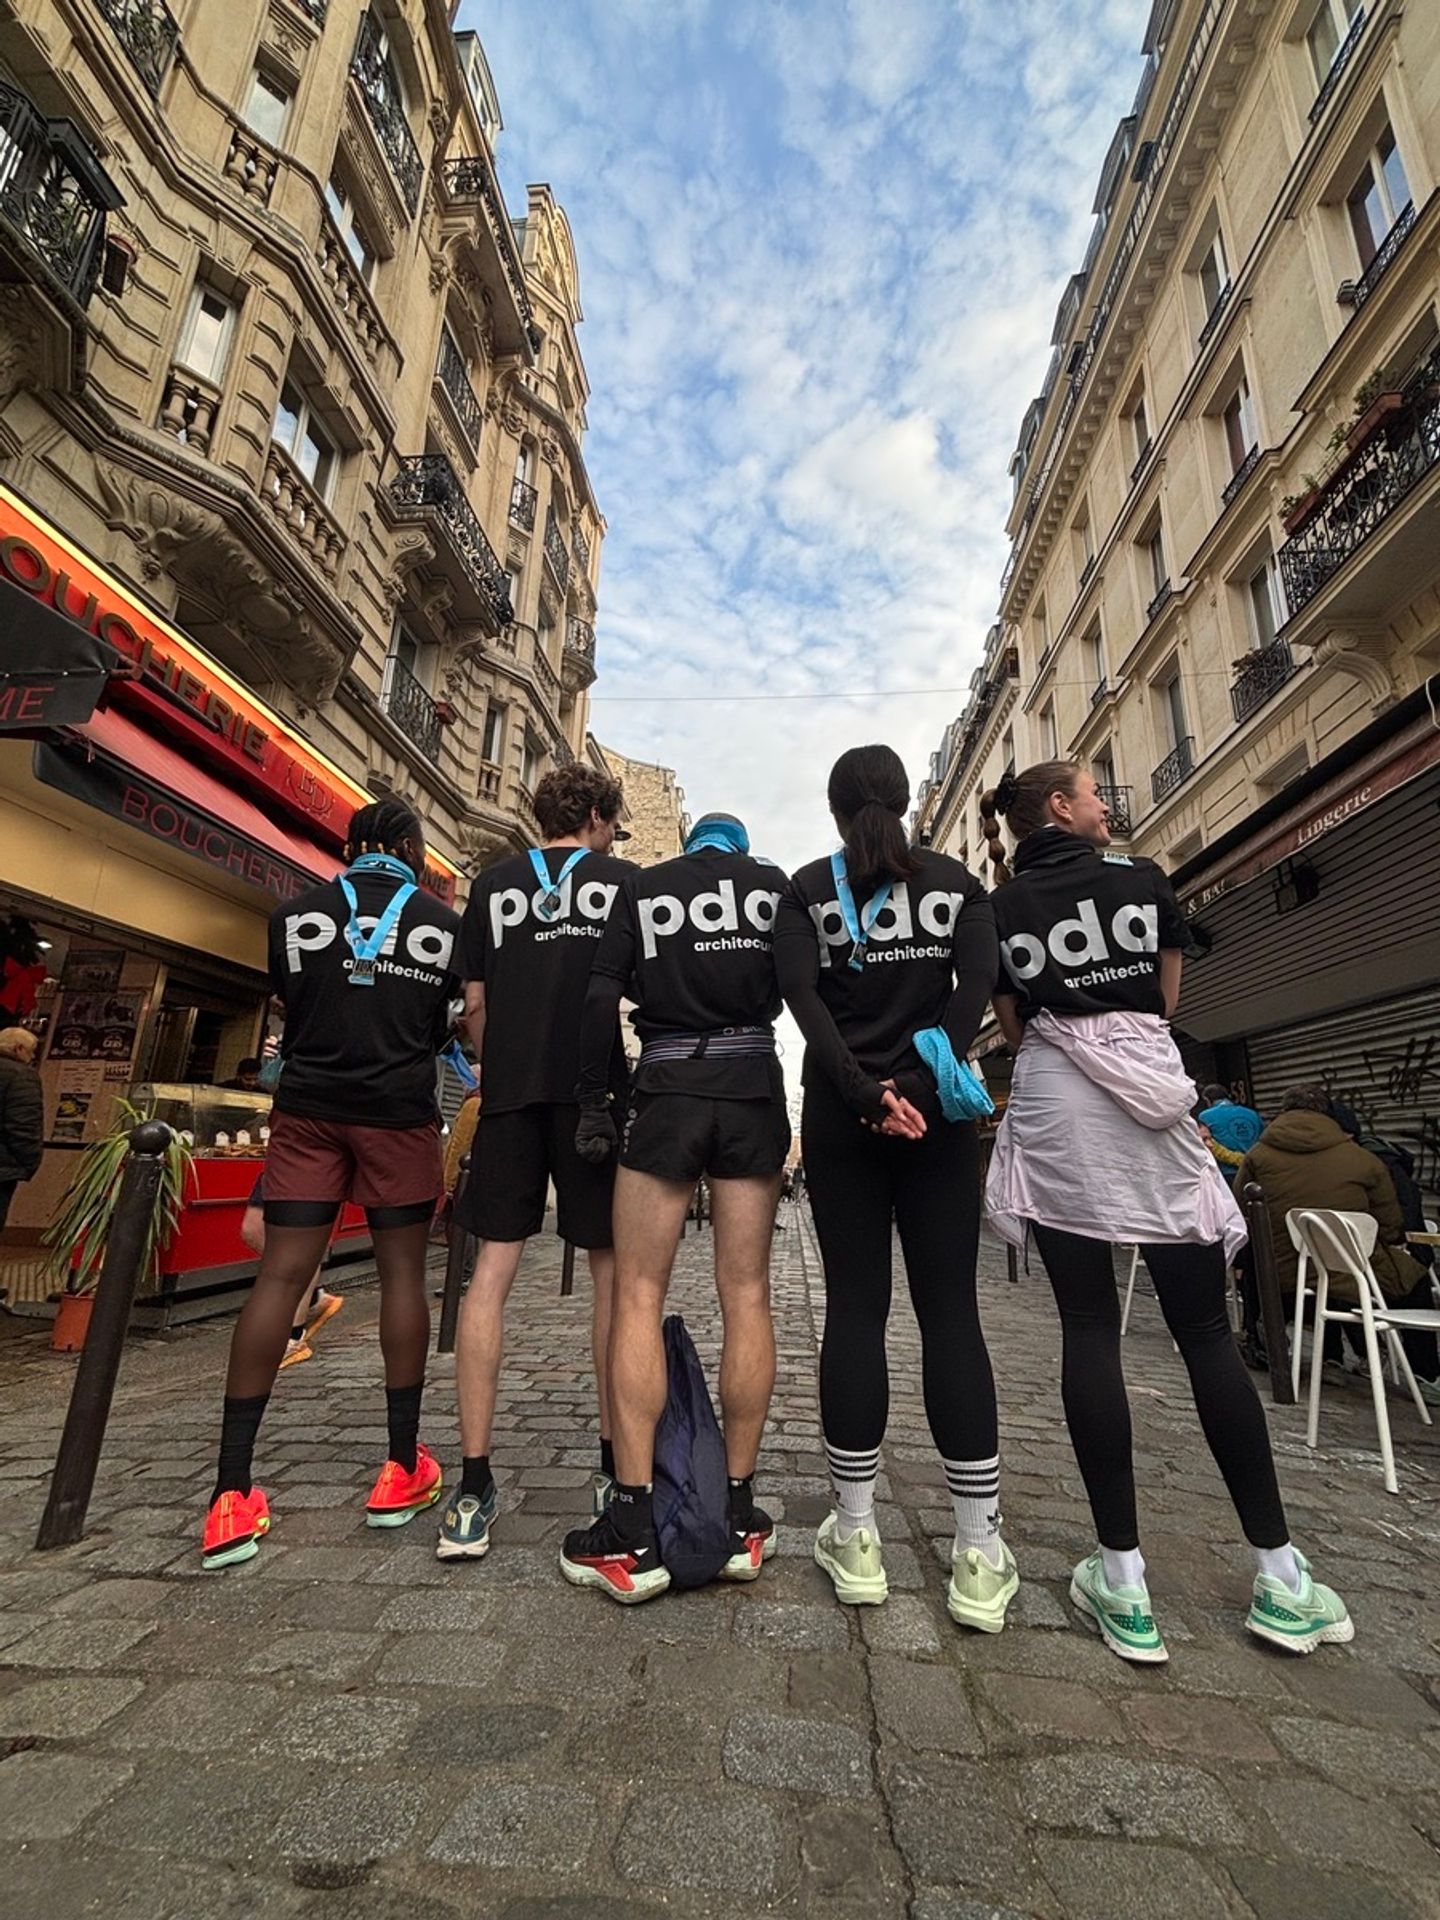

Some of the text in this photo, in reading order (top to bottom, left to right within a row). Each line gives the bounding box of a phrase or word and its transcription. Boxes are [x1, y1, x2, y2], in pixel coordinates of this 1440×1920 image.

[121, 786, 305, 899] BOUCHERIE
[1297, 786, 1371, 846] Lingerie
[637, 879, 783, 960] pda
[808, 881, 965, 968] pda
[342, 958, 444, 987] ahitecture
